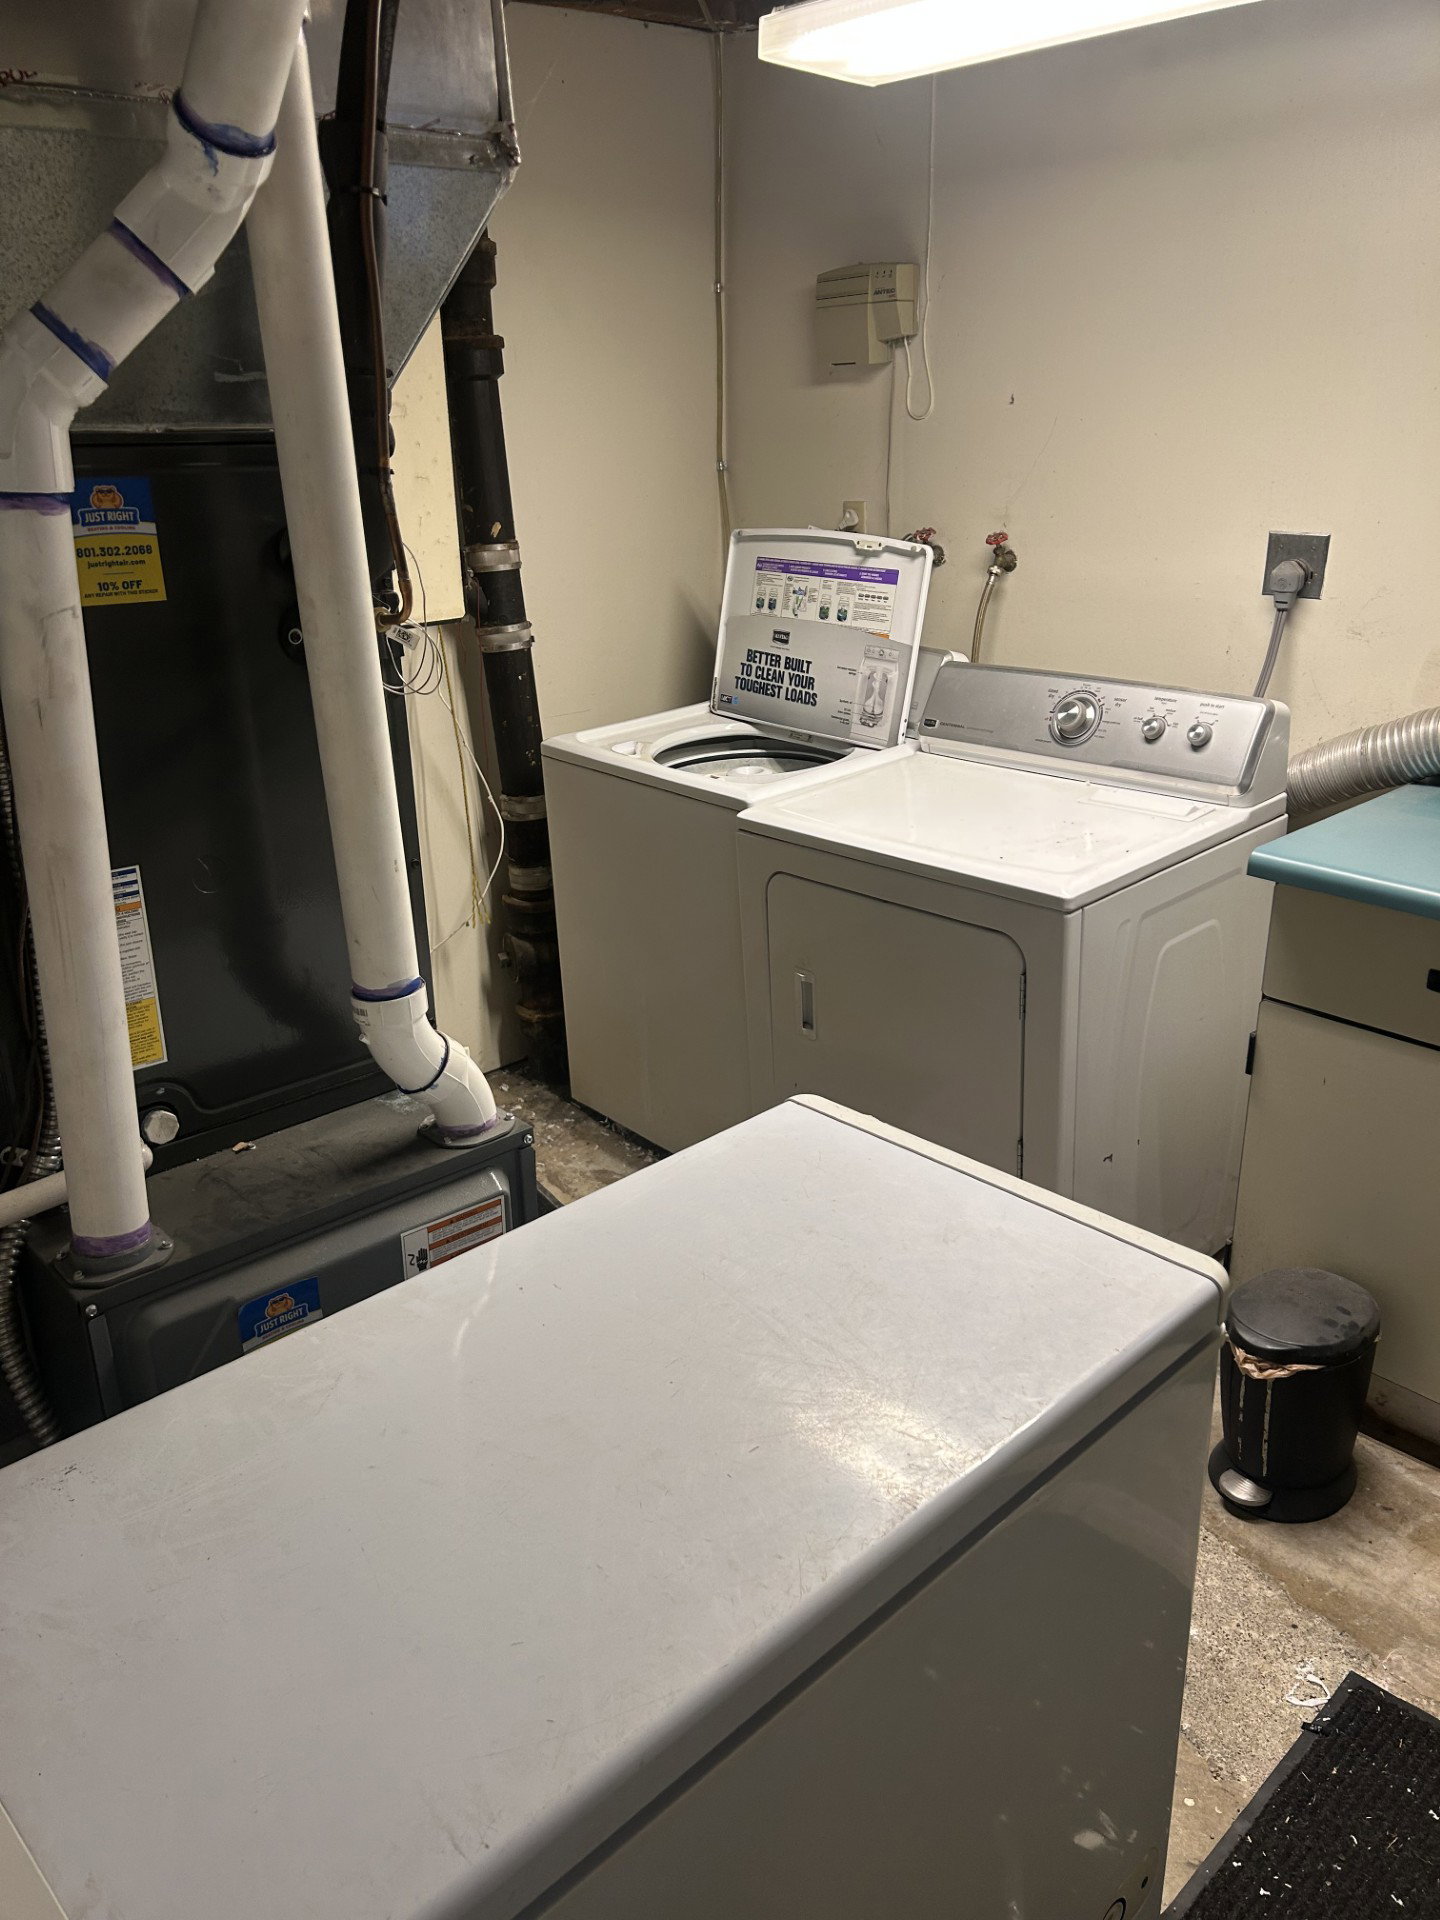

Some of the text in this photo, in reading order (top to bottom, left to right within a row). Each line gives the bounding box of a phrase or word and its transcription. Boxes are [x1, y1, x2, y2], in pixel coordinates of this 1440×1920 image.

[85, 511, 134, 523] JUST RIGHT
[76, 545, 152, 557] 801.302.2068
[88, 560, 145, 568] justrightair.com
[97, 580, 143, 592] 10% OFF
[746, 648, 781, 669] BETTER
[784, 656, 813, 674] BUILT
[740, 662, 816, 691] TO CLEAN YOUR
[734, 676, 783, 699] TOUGHEST
[785, 686, 818, 707] LOADS
[260, 1318, 278, 1334] JUST
[279, 1307, 304, 1323] RIGHT
